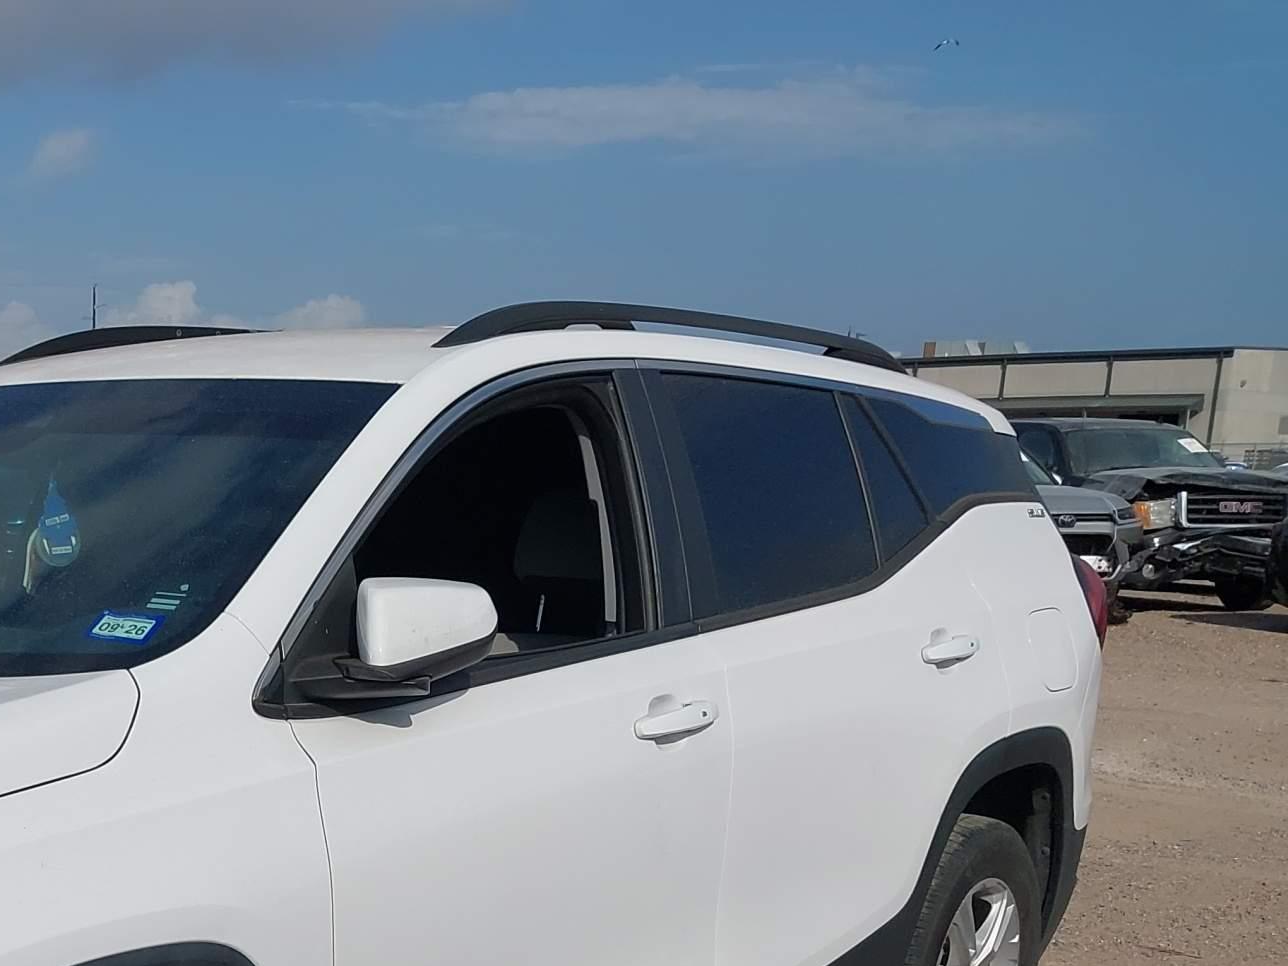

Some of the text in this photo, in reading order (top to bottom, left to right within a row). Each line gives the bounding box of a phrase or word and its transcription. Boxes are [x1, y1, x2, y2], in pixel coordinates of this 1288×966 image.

[1219, 501, 1263, 513] GMC
[98, 622, 148, 636] 09 26
